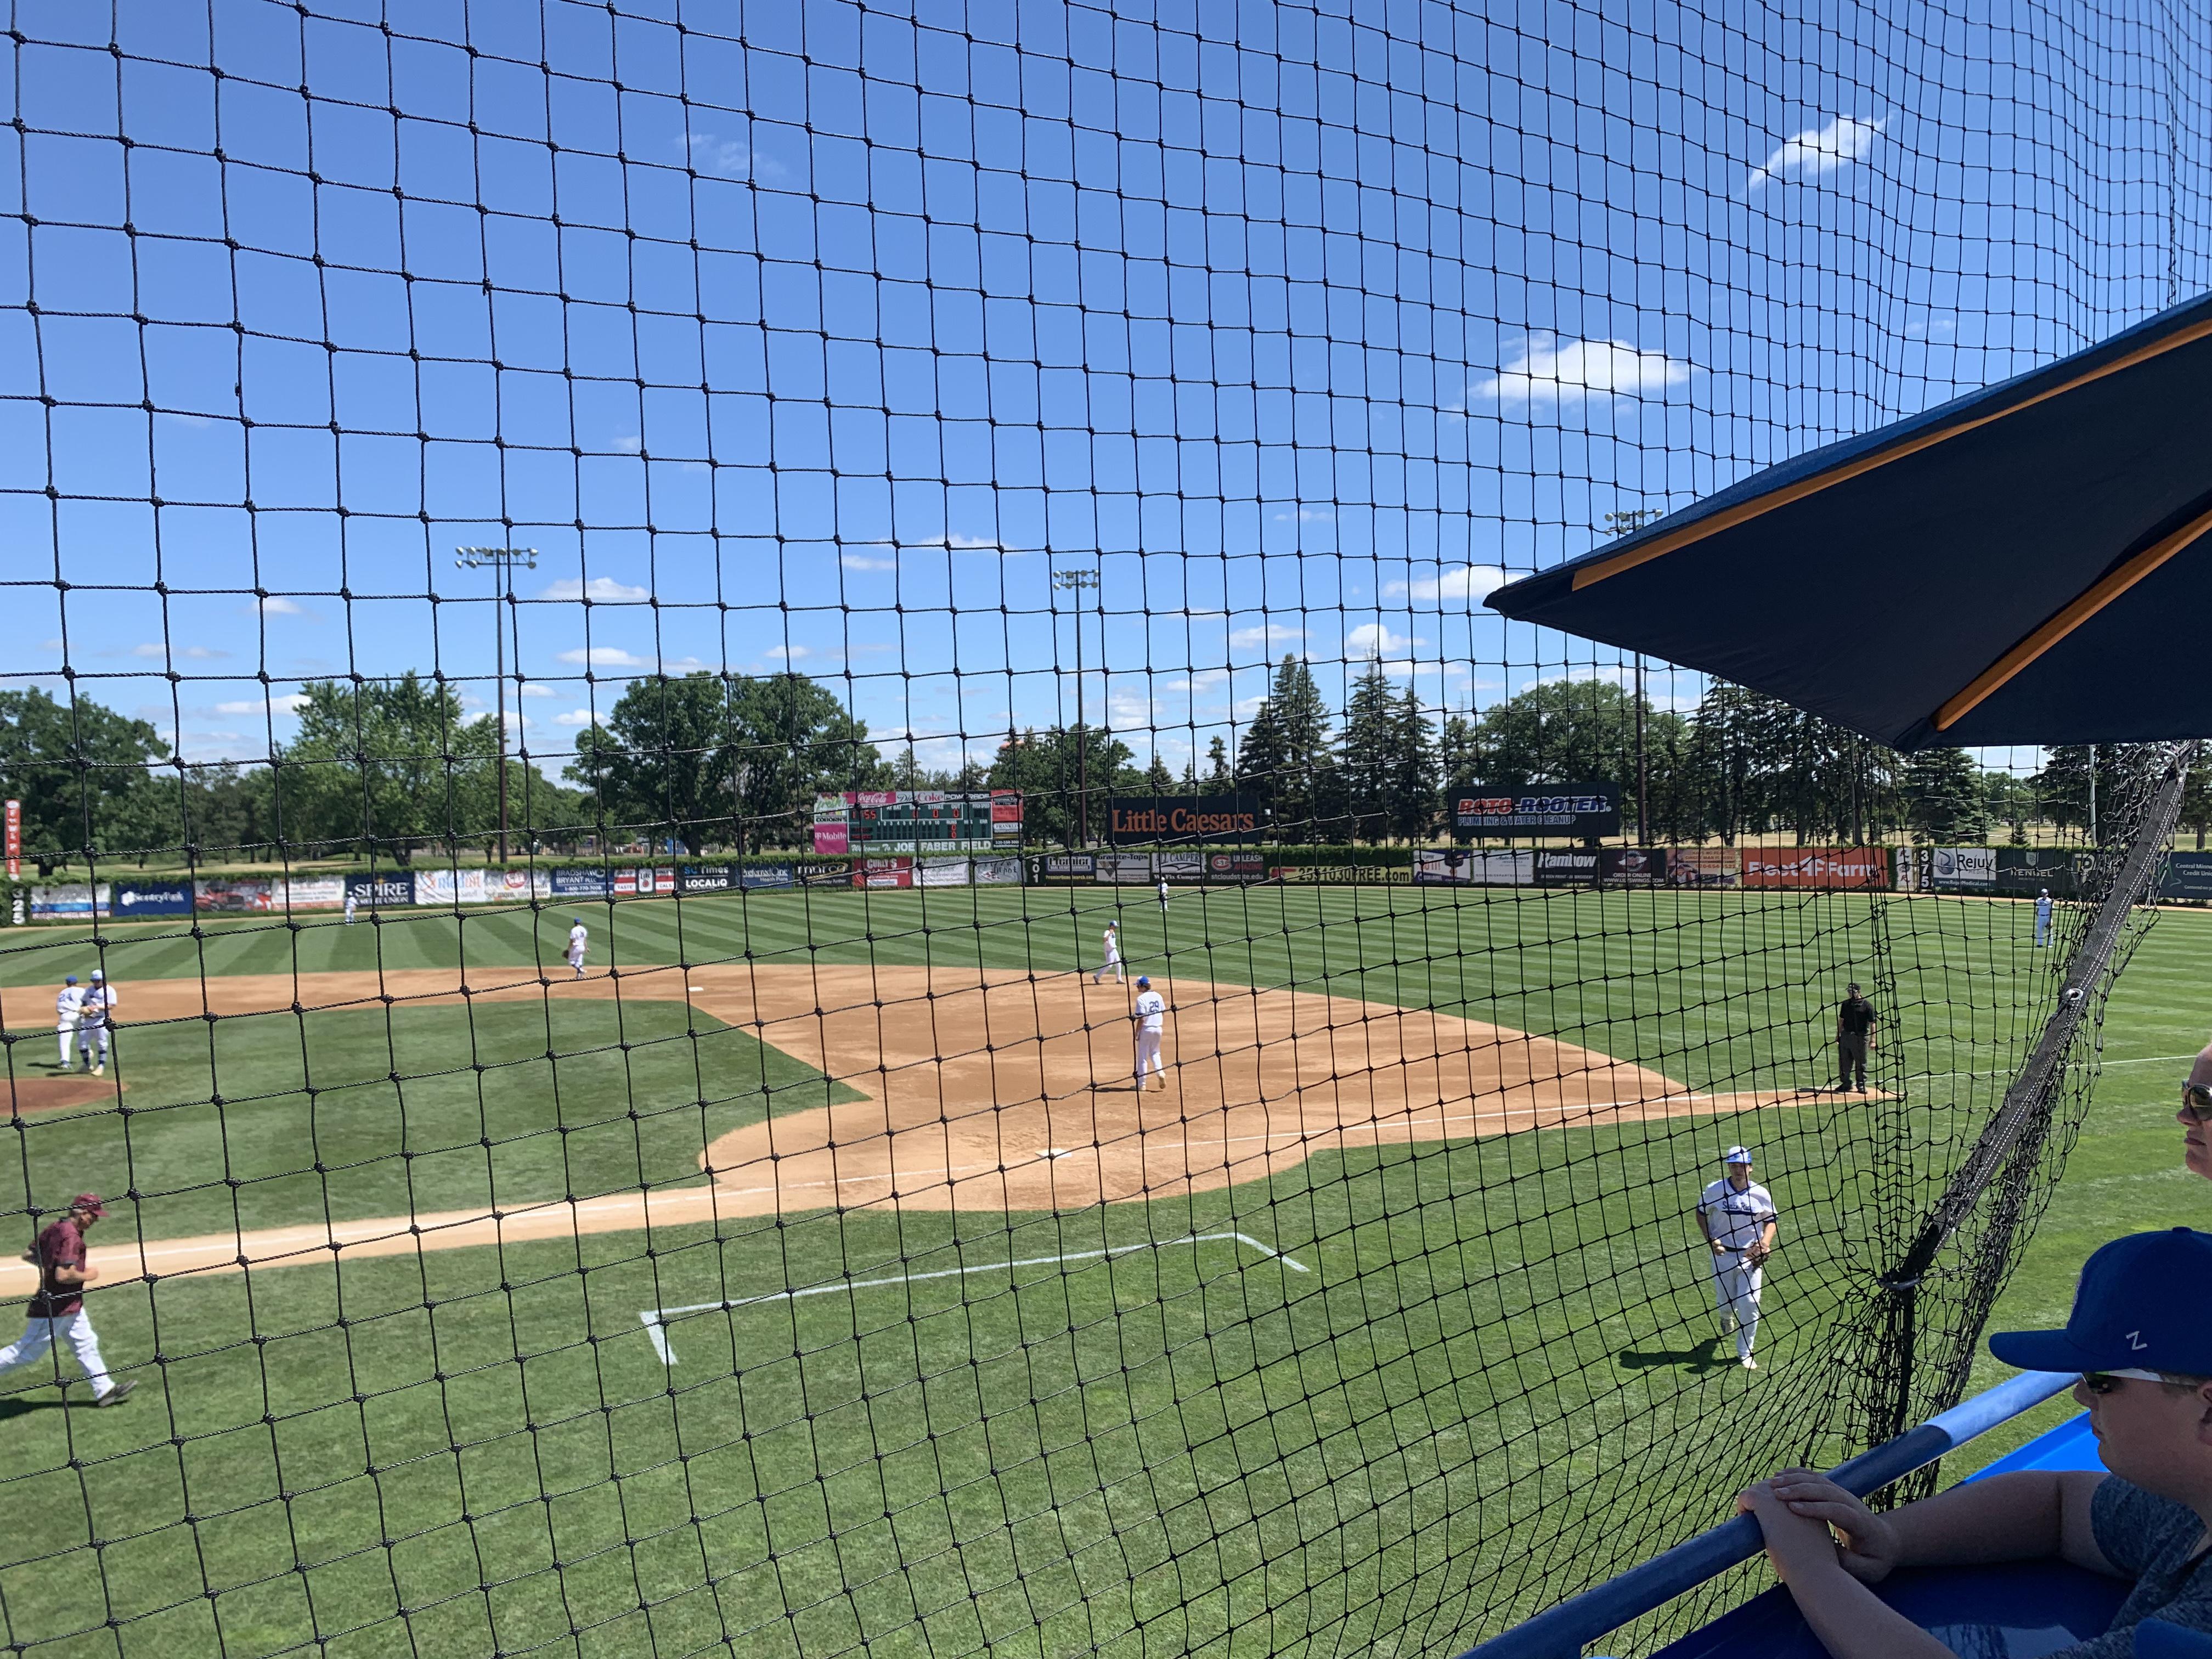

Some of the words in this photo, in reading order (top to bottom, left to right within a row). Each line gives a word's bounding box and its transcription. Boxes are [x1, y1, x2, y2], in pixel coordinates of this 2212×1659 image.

[917, 792, 943, 802] Coke
[1113, 809, 1167, 832] Little
[1171, 808, 1255, 832] Caesars
[1500, 815, 1508, 825] &
[823, 832, 847, 840] Mobile
[894, 842, 915, 852] JOE
[921, 841, 956, 851] FABER
[961, 840, 991, 850] FIELD
[1748, 862, 1798, 876] Fleet
[1826, 861, 1875, 876] Farm
[1921, 850, 1929, 887] 375
[1958, 854, 1992, 870] Rejuv
[355, 882, 409, 897] SPIRE
[12, 888, 25, 924] 325
